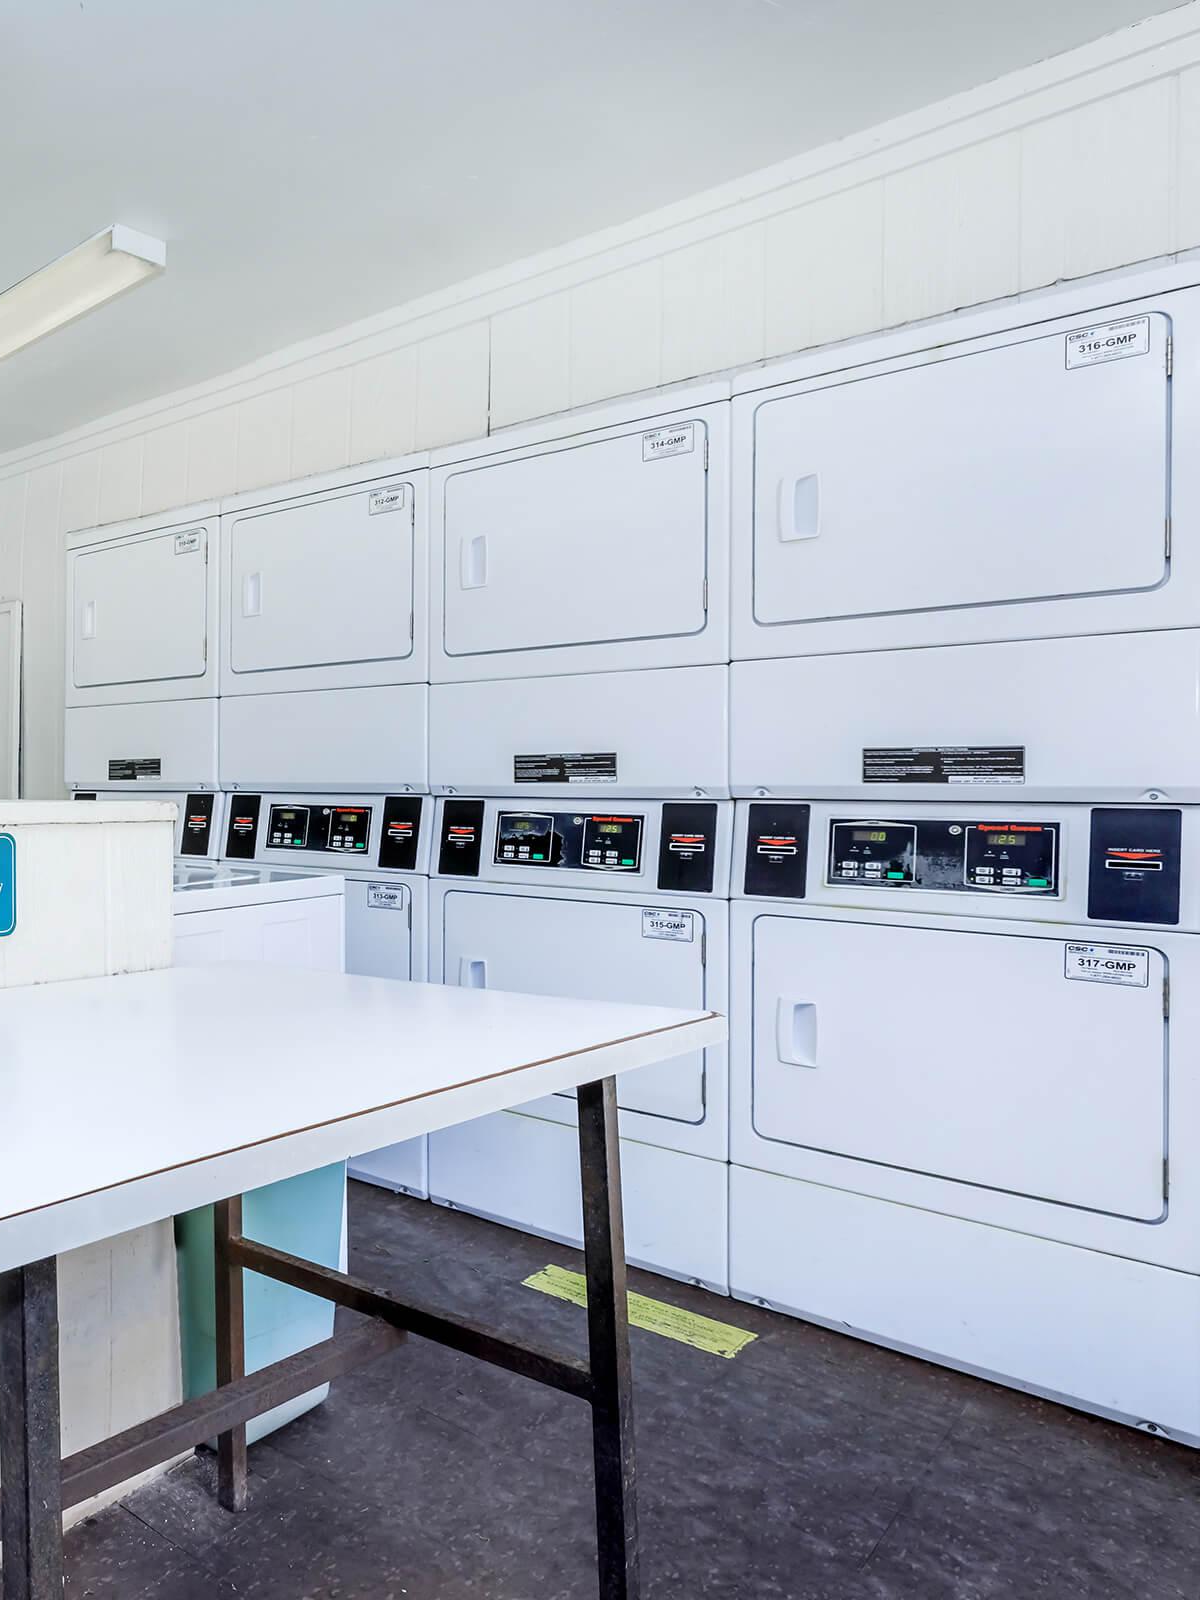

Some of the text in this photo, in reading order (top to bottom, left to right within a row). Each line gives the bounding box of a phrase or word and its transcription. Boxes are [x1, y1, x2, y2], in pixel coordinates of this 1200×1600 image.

[1068, 332, 1089, 341] CSC
[1078, 333, 1137, 353] 316-GMP
[650, 435, 687, 450] 314-GMP
[649, 920, 686, 930] 315-GMP
[1077, 958, 1137, 971] 317-GMP
